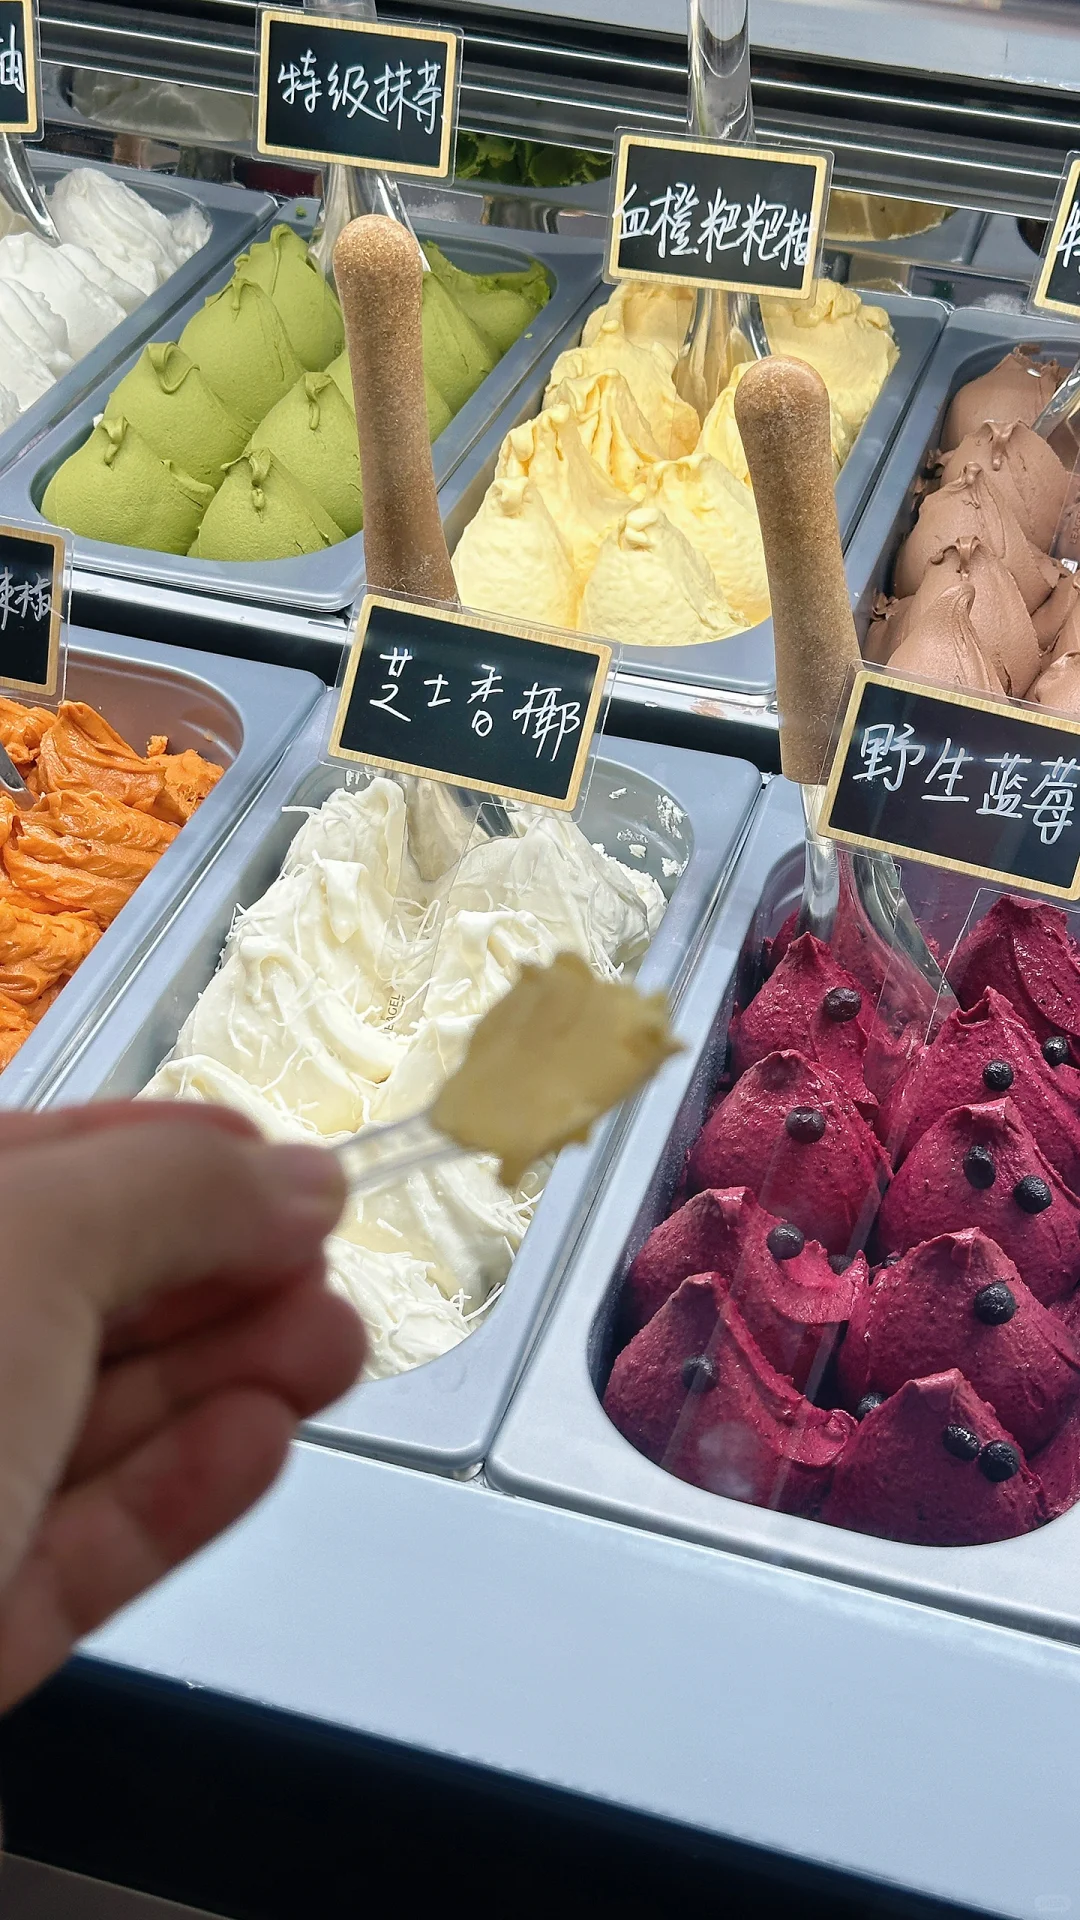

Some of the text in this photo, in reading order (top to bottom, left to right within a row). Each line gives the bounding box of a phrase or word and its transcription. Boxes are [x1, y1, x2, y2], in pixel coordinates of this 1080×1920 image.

[277, 48, 442, 135] 特级抹茶
[369, 647, 581, 762] 芝士香椰
[852, 723, 1080, 845] 野生蓝莓
